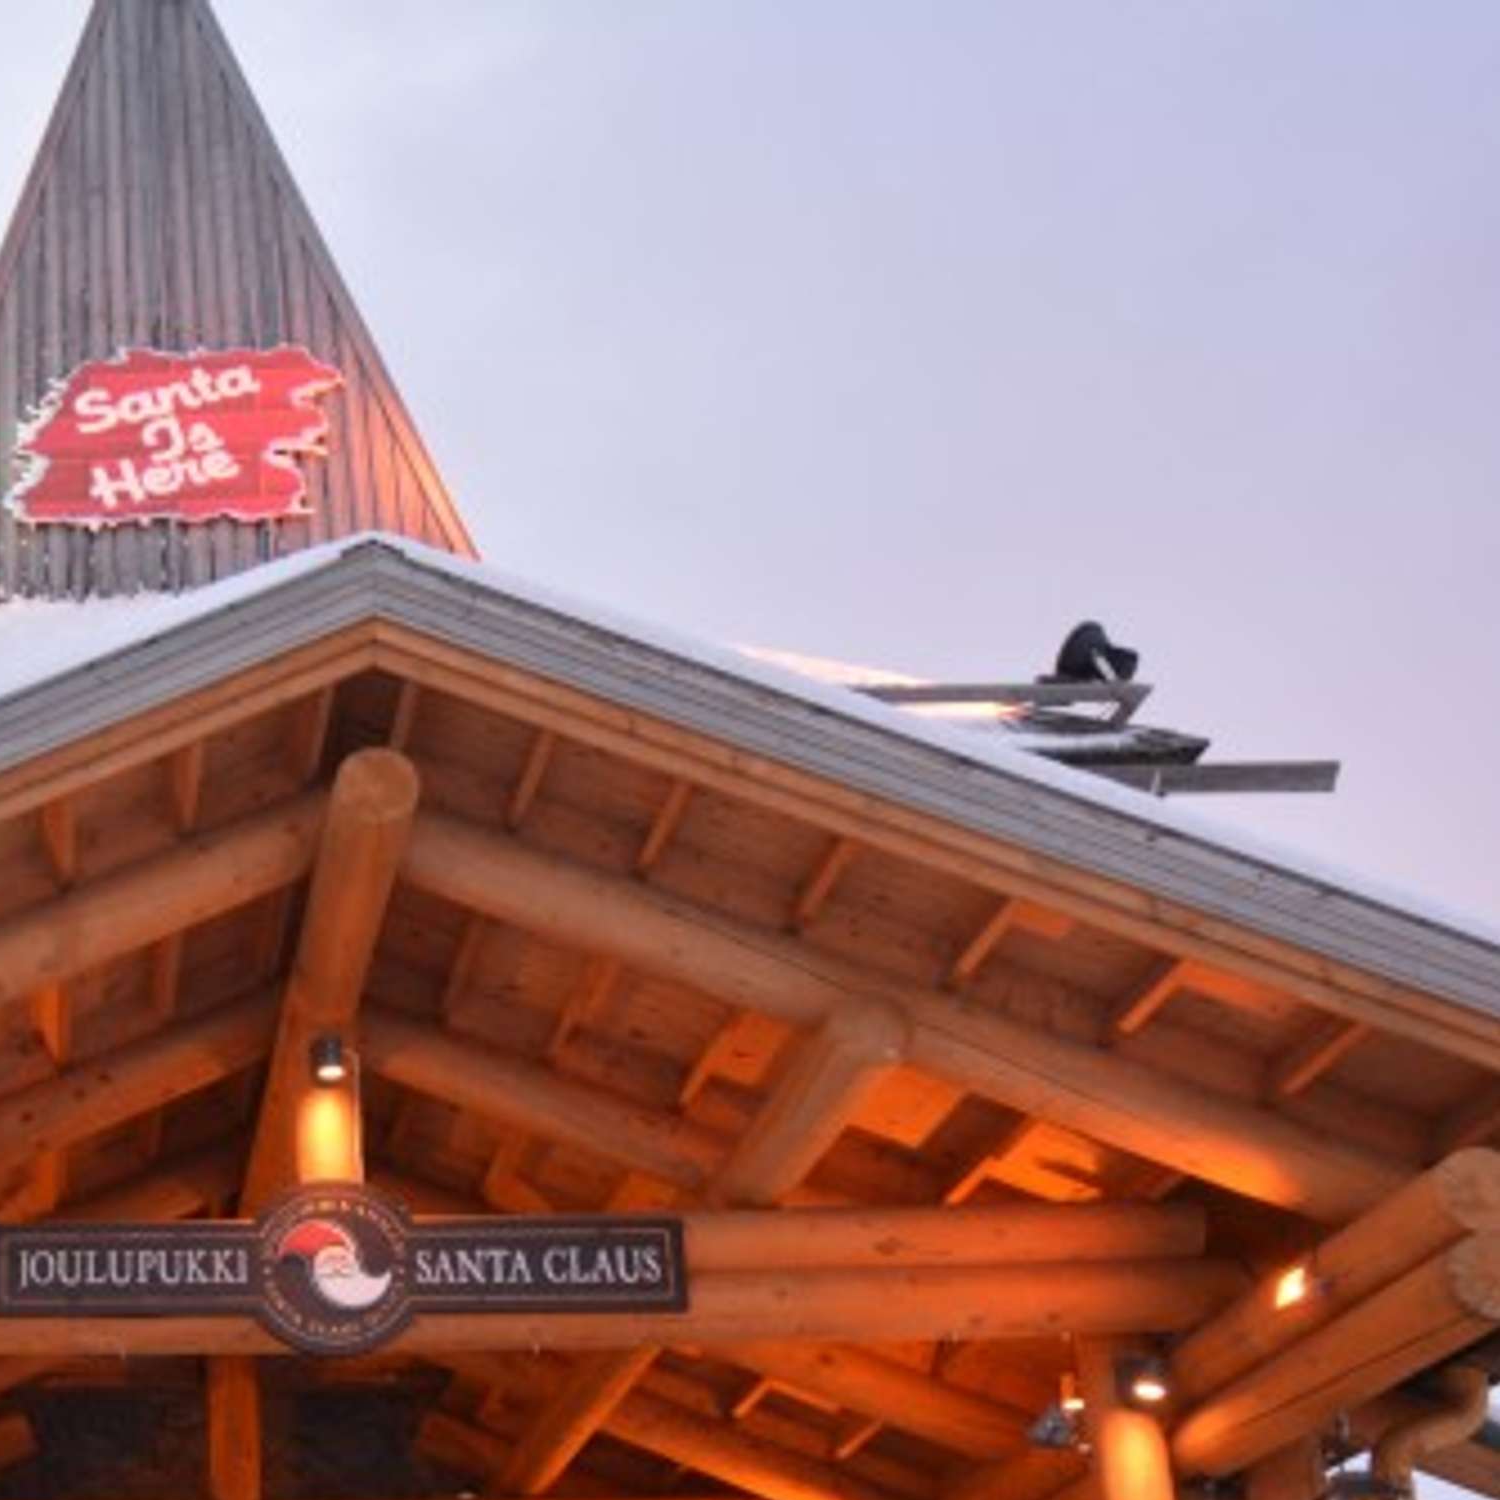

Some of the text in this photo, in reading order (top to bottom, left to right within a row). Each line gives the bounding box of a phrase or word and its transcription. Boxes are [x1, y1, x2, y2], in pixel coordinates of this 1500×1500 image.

[74, 364, 261, 434] Santa
[142, 414, 224, 461] Is
[90, 449, 239, 508] Here
[19, 1245, 663, 1289] JOULUPUKKI SANTA CLAUS
